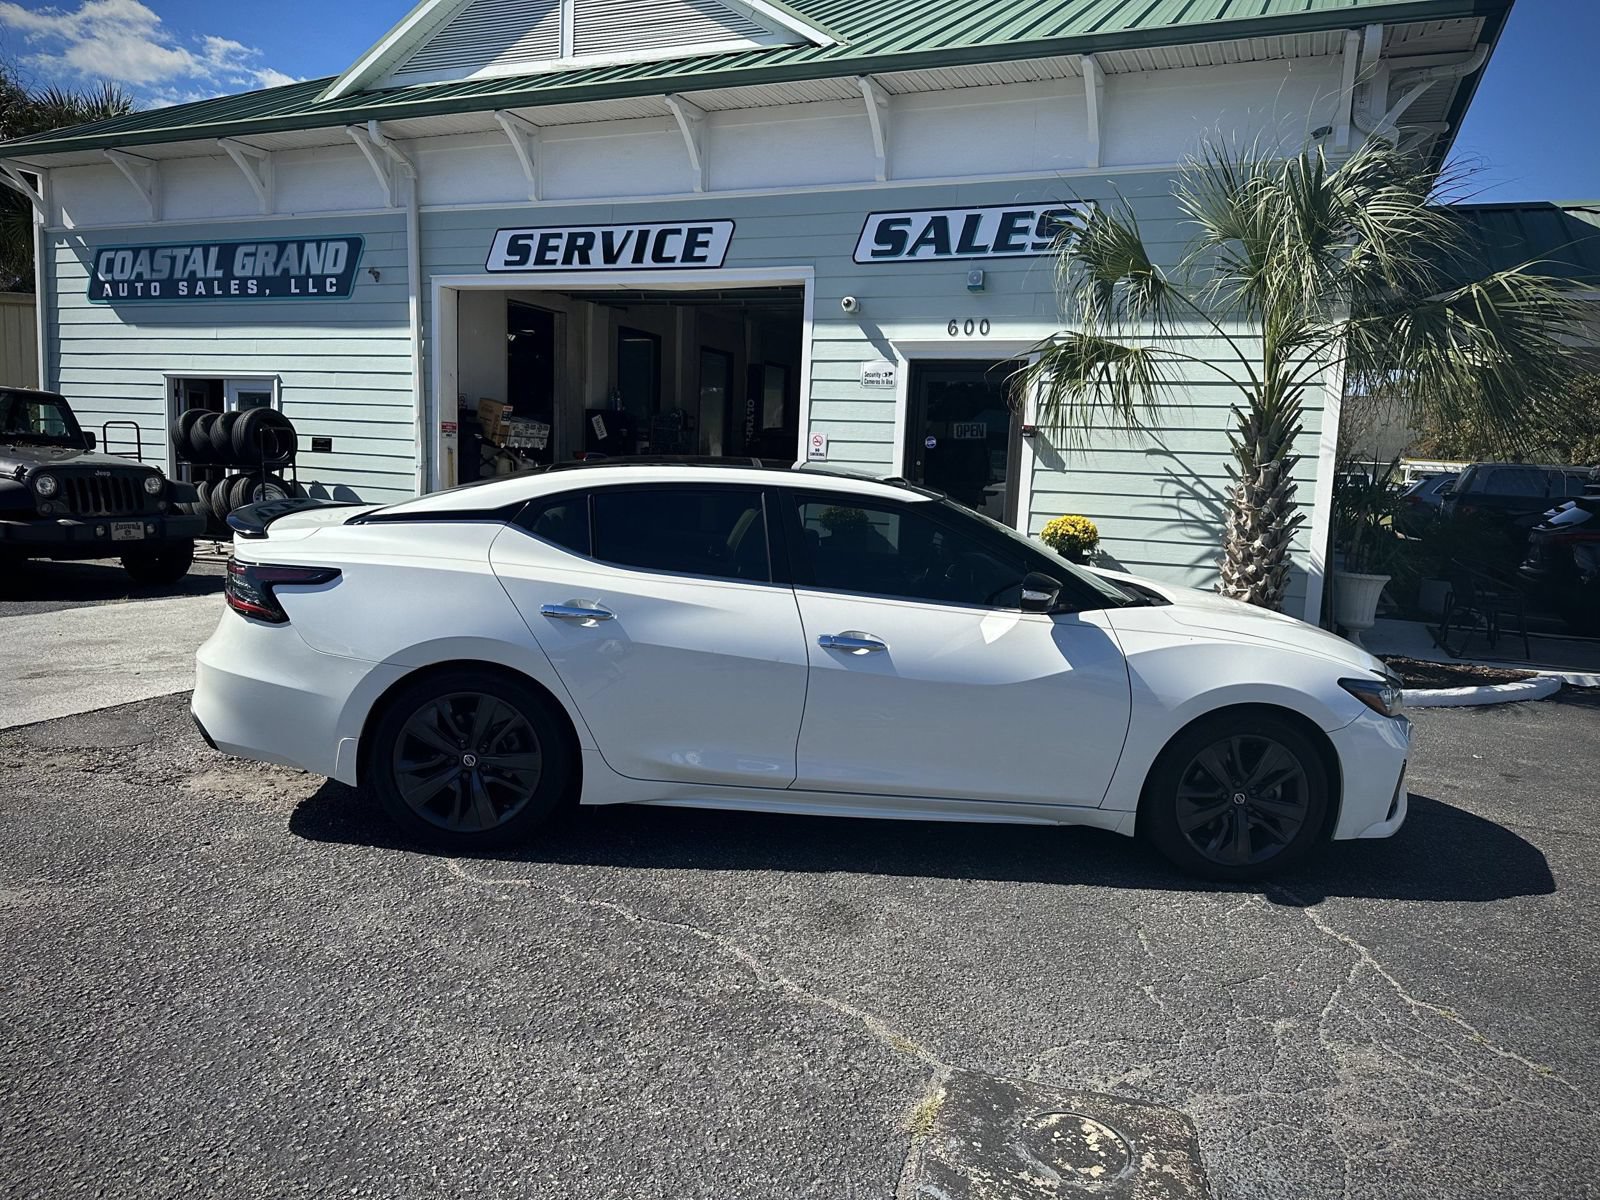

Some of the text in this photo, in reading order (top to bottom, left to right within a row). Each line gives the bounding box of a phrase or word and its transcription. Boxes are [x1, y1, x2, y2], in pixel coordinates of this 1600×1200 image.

[870, 207, 1077, 257] SALES
[503, 226, 714, 267] SERVICE
[99, 241, 349, 281] COASTAL GRAND
[102, 277, 338, 297] AUTO SALES, LLC
[947, 318, 991, 337] 600
[956, 424, 985, 438] OPEN
[94, 469, 111, 477] Jeep
